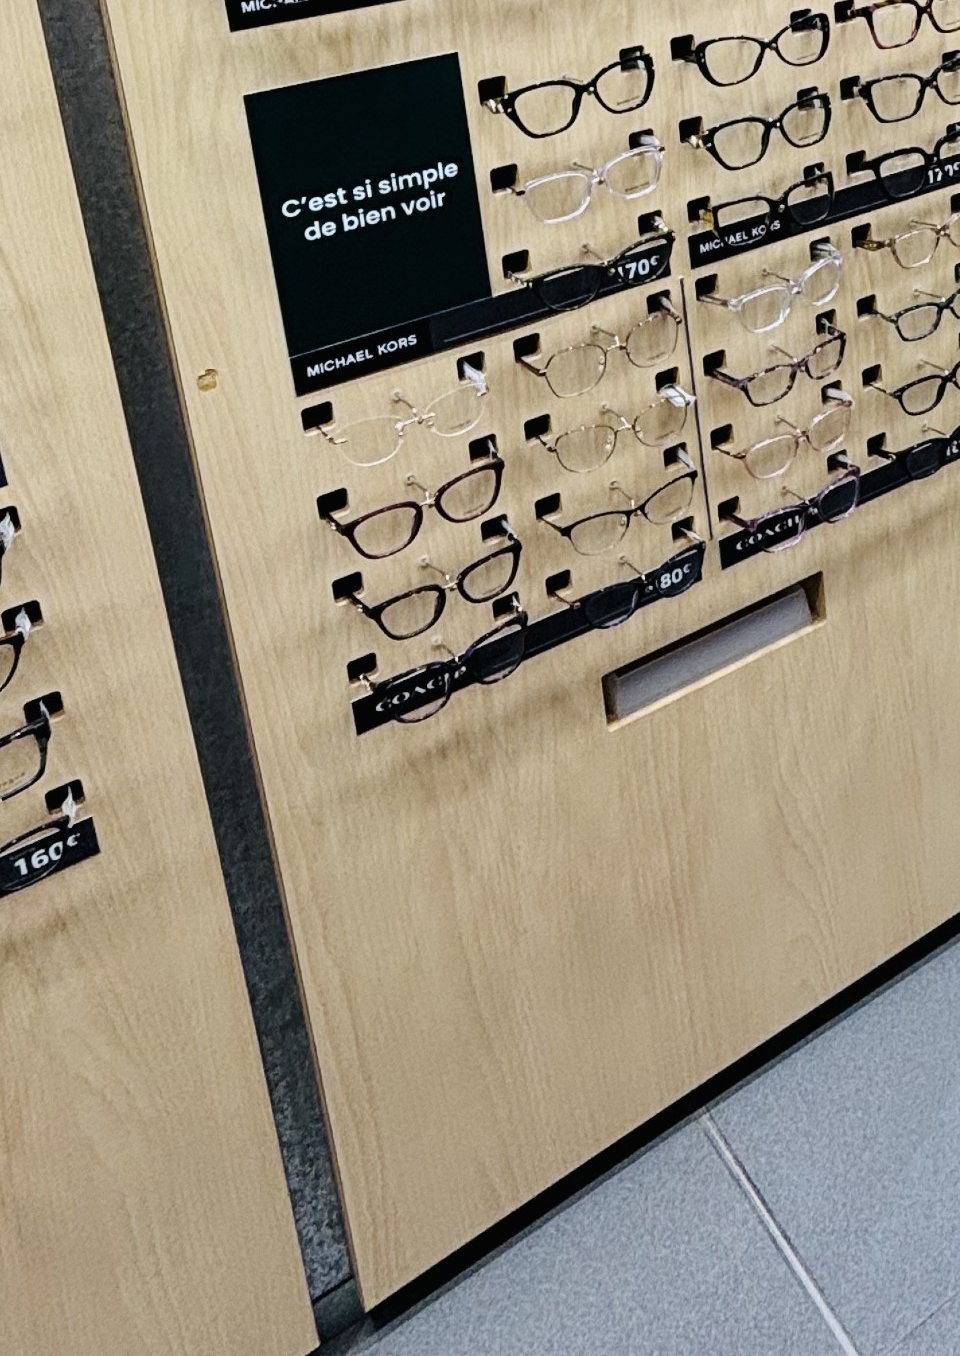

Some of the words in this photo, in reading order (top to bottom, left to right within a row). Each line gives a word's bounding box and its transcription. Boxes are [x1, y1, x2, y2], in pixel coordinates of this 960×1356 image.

[281, 187, 348, 218] C'est
[352, 178, 373, 201] si
[378, 161, 459, 195] simple
[304, 220, 337, 241] de
[341, 205, 396, 232] bien
[400, 190, 447, 216] voir
[306, 348, 374, 378] MICHAEL
[377, 333, 418, 356] KORS
[659, 563, 692, 590] 80€
